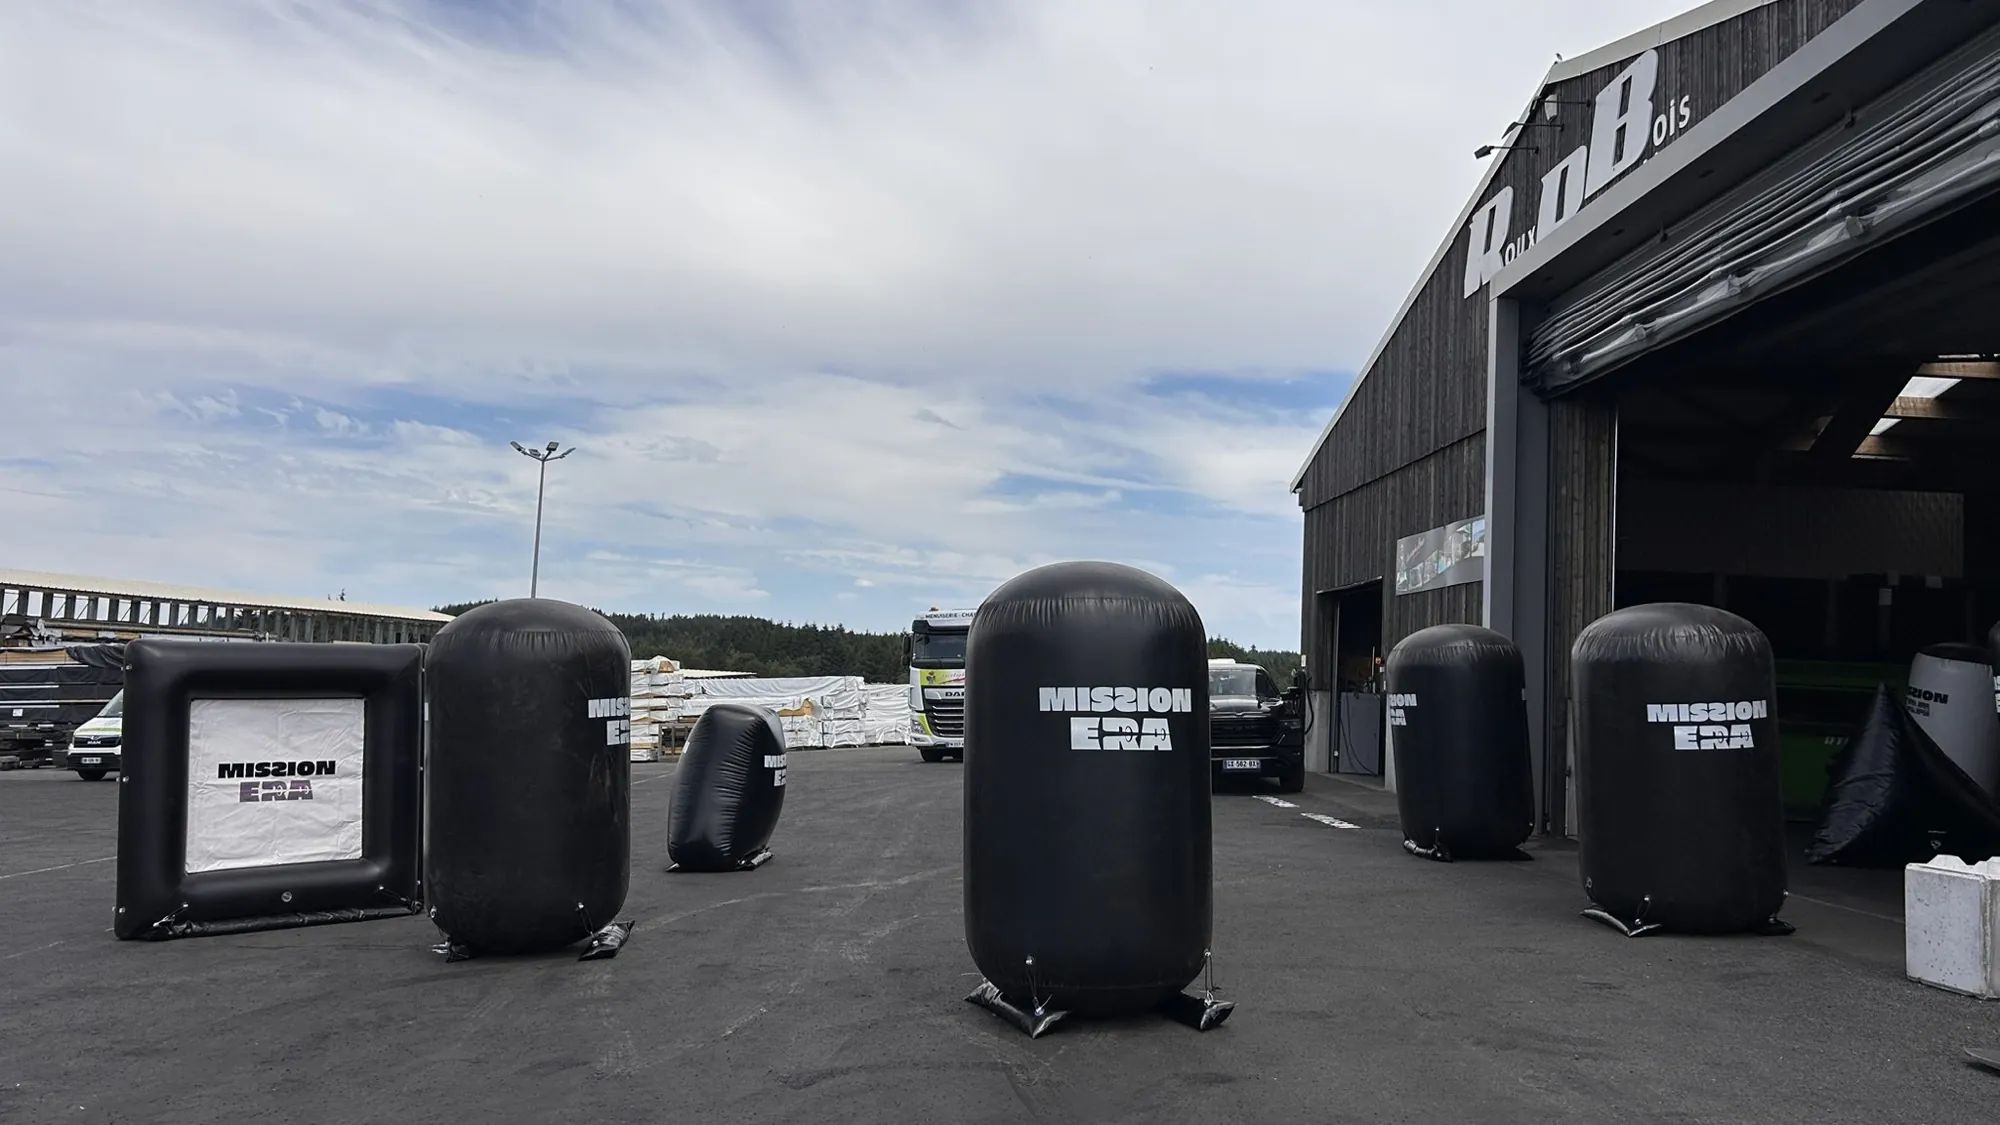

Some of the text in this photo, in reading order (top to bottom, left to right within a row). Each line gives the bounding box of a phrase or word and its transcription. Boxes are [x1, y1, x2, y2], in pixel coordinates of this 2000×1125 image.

[1584, 48, 1691, 201] Bois
[1038, 686, 1192, 713] MISSION
[1646, 699, 1768, 722] MISSION
[1070, 716, 1173, 751] ERA
[1673, 723, 1755, 750] ERA
[218, 760, 336, 779] MISSION
[239, 779, 314, 803] ERA
